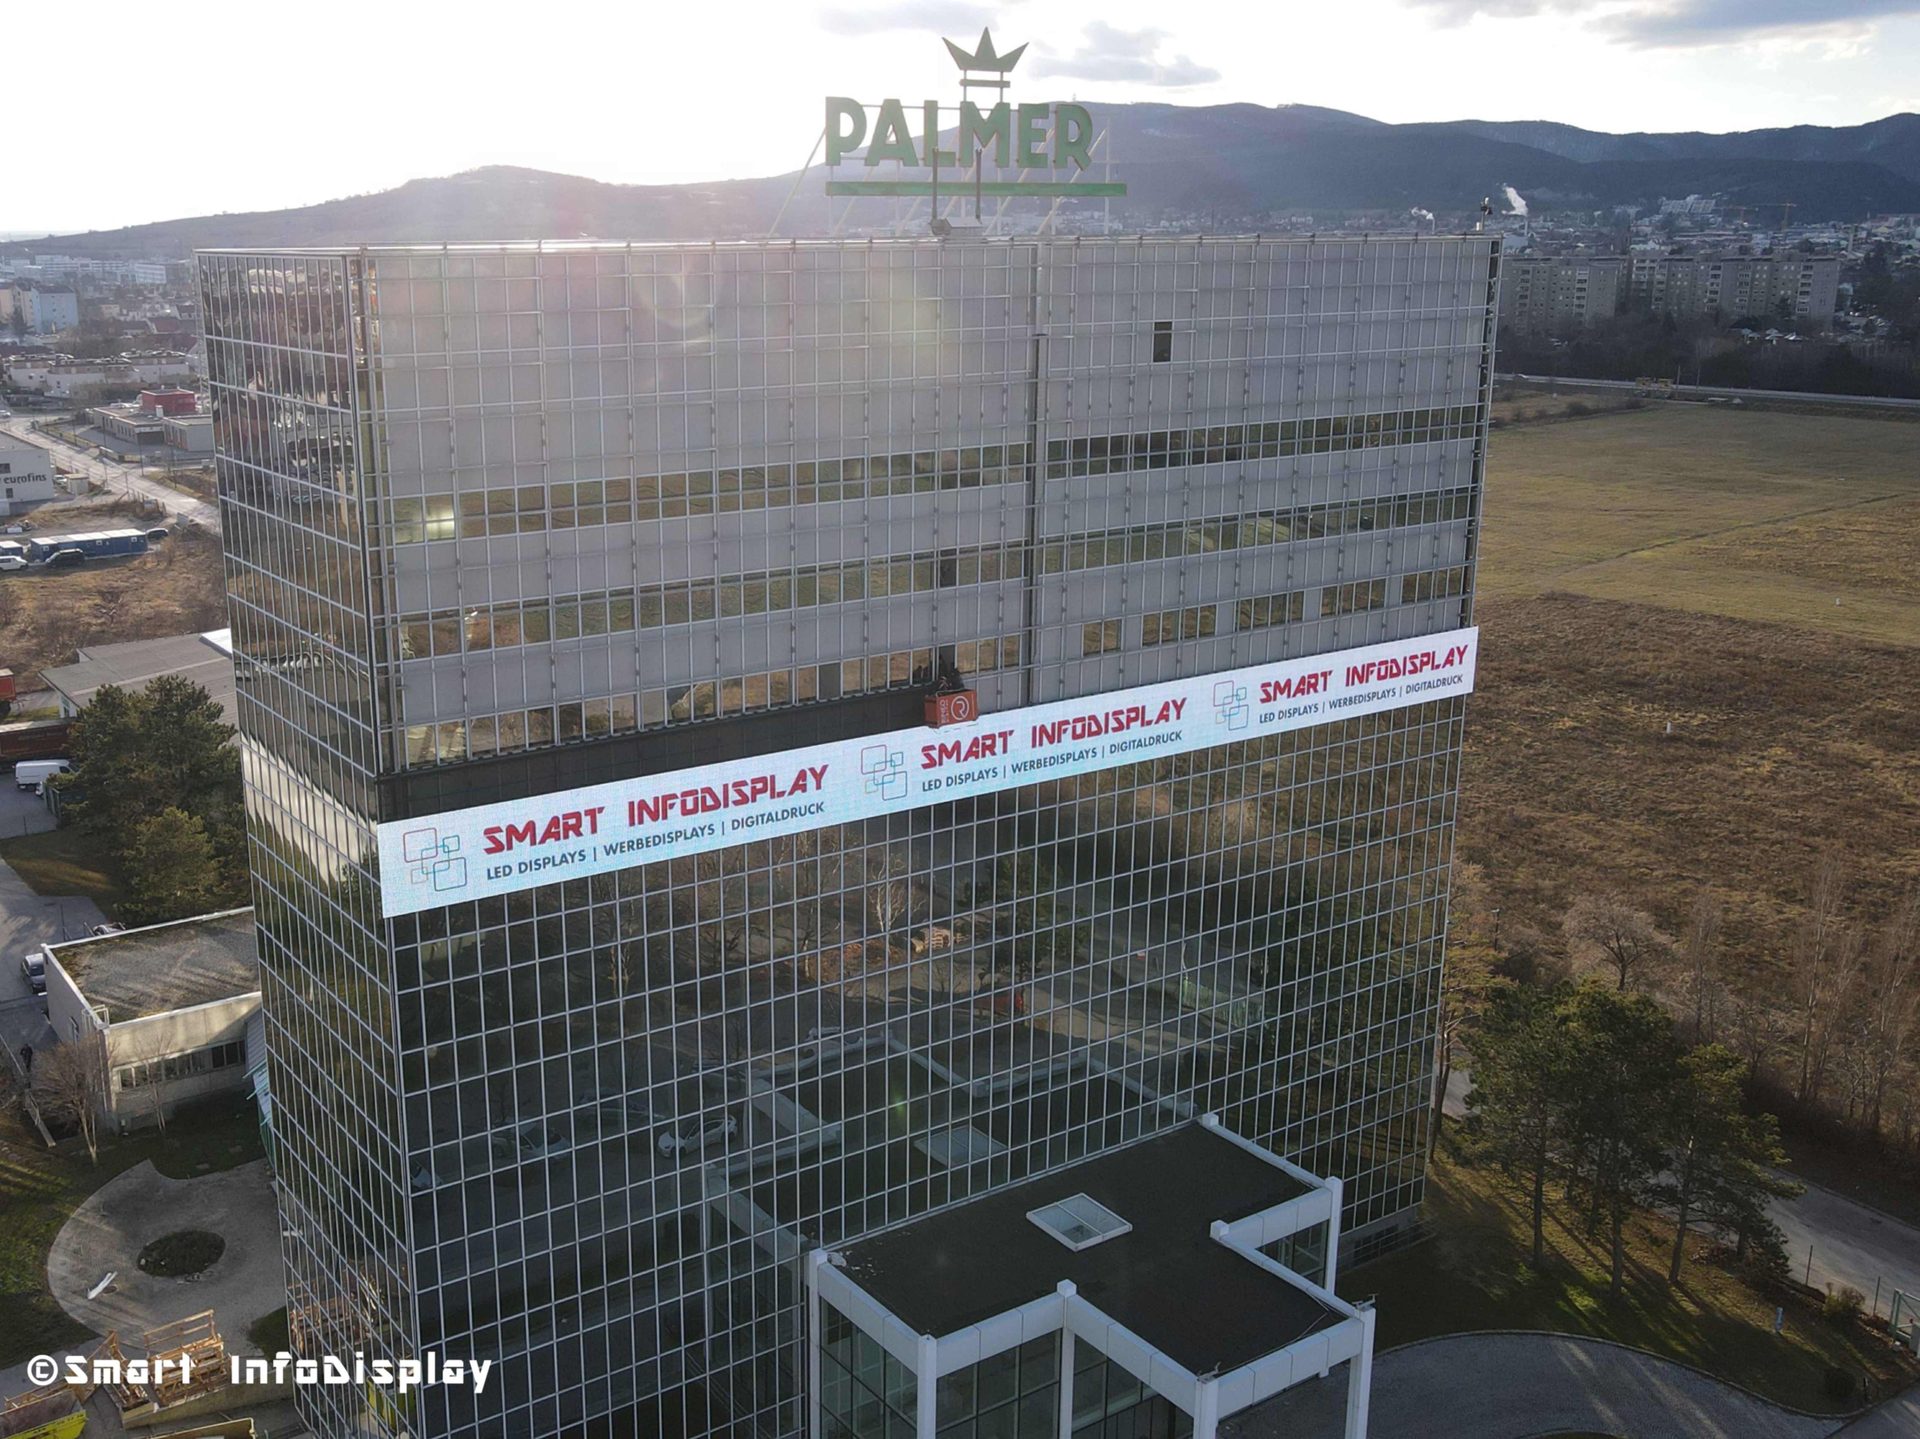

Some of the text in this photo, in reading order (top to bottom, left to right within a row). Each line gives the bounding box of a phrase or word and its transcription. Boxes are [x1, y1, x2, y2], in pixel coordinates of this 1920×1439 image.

[825, 96, 1093, 170] PALMER
[3, 472, 47, 484] eurofins
[1259, 644, 1469, 704] SMART INFODISPLAY
[1259, 674, 1464, 724] LED DISPLAYS WERBEDISPLAYS DIGITALDRUCK
[921, 697, 1188, 770] SMART INFODISPLAY
[922, 729, 1183, 793] LED DISPLAYS WERBEDISPLAYS DIGITALDRUCK
[484, 764, 829, 855] SMART INFODISPLAY
[487, 801, 826, 881] LED DISPLAYS WERBEDISPLAYS DIGITALDRUCK
